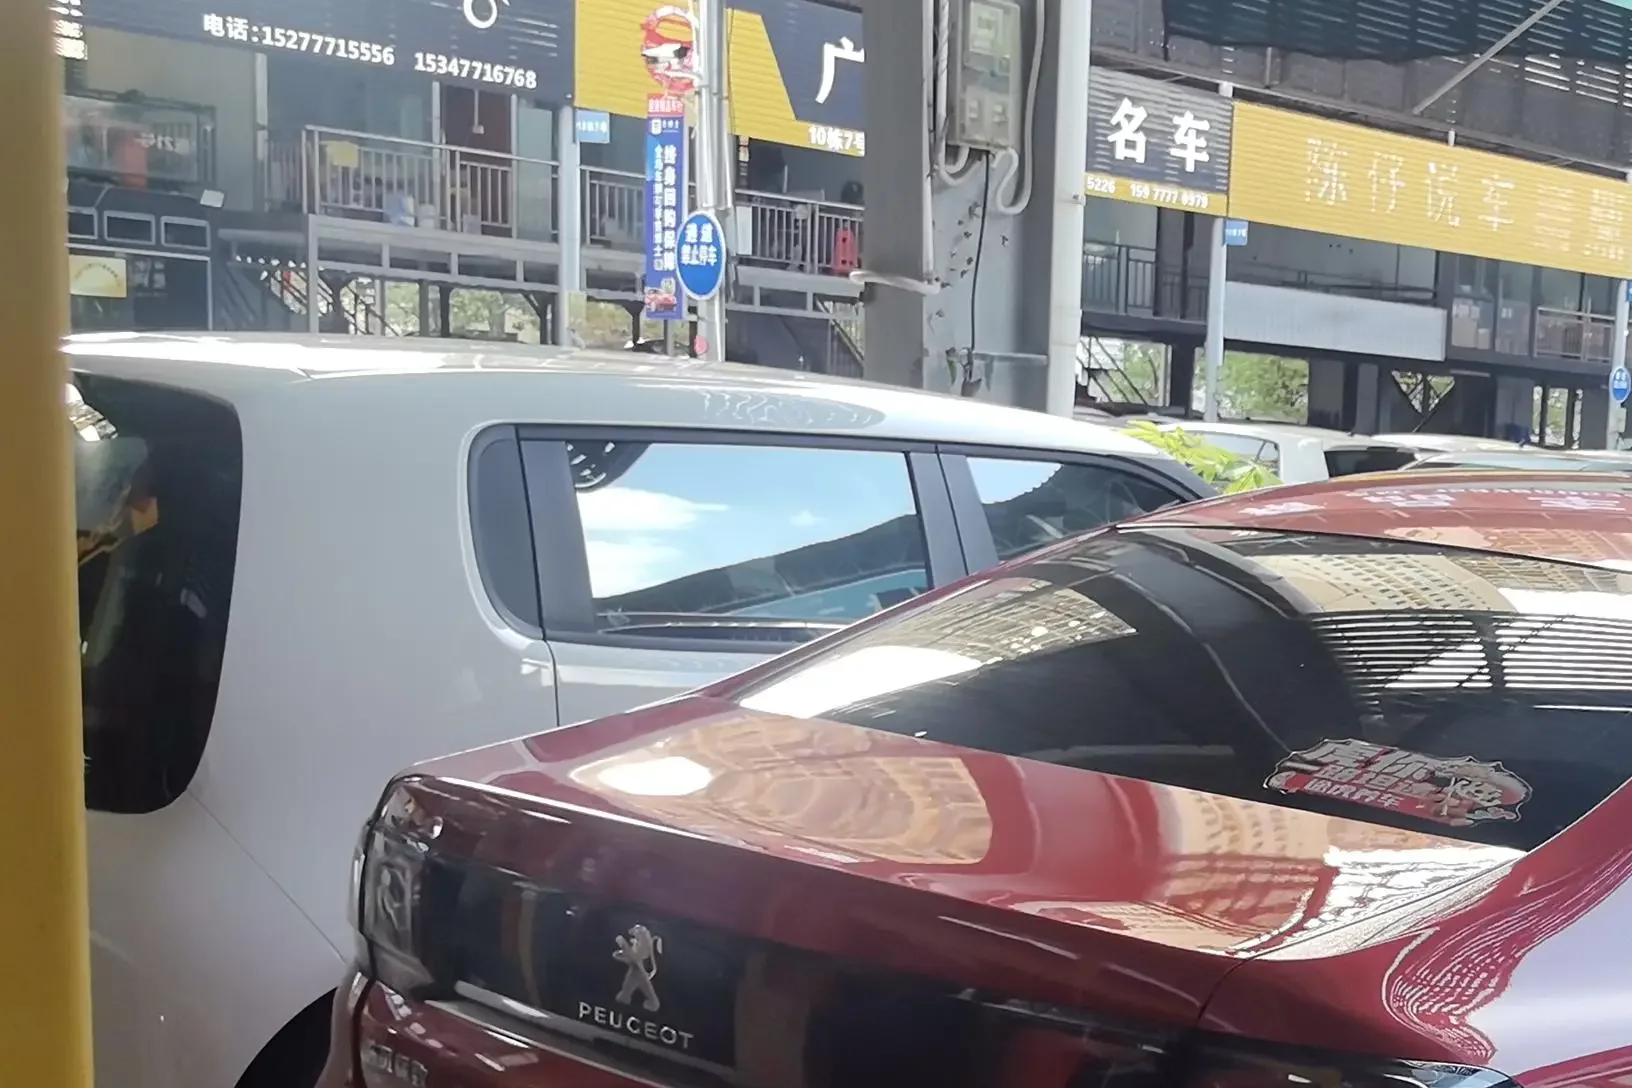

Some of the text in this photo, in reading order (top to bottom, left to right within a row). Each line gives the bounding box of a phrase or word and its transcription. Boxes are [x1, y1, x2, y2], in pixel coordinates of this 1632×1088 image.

[414, 52, 538, 90] 15347716768
[1107, 97, 1210, 173] 名车
[579, 1001, 694, 1049] PEUGEOT
